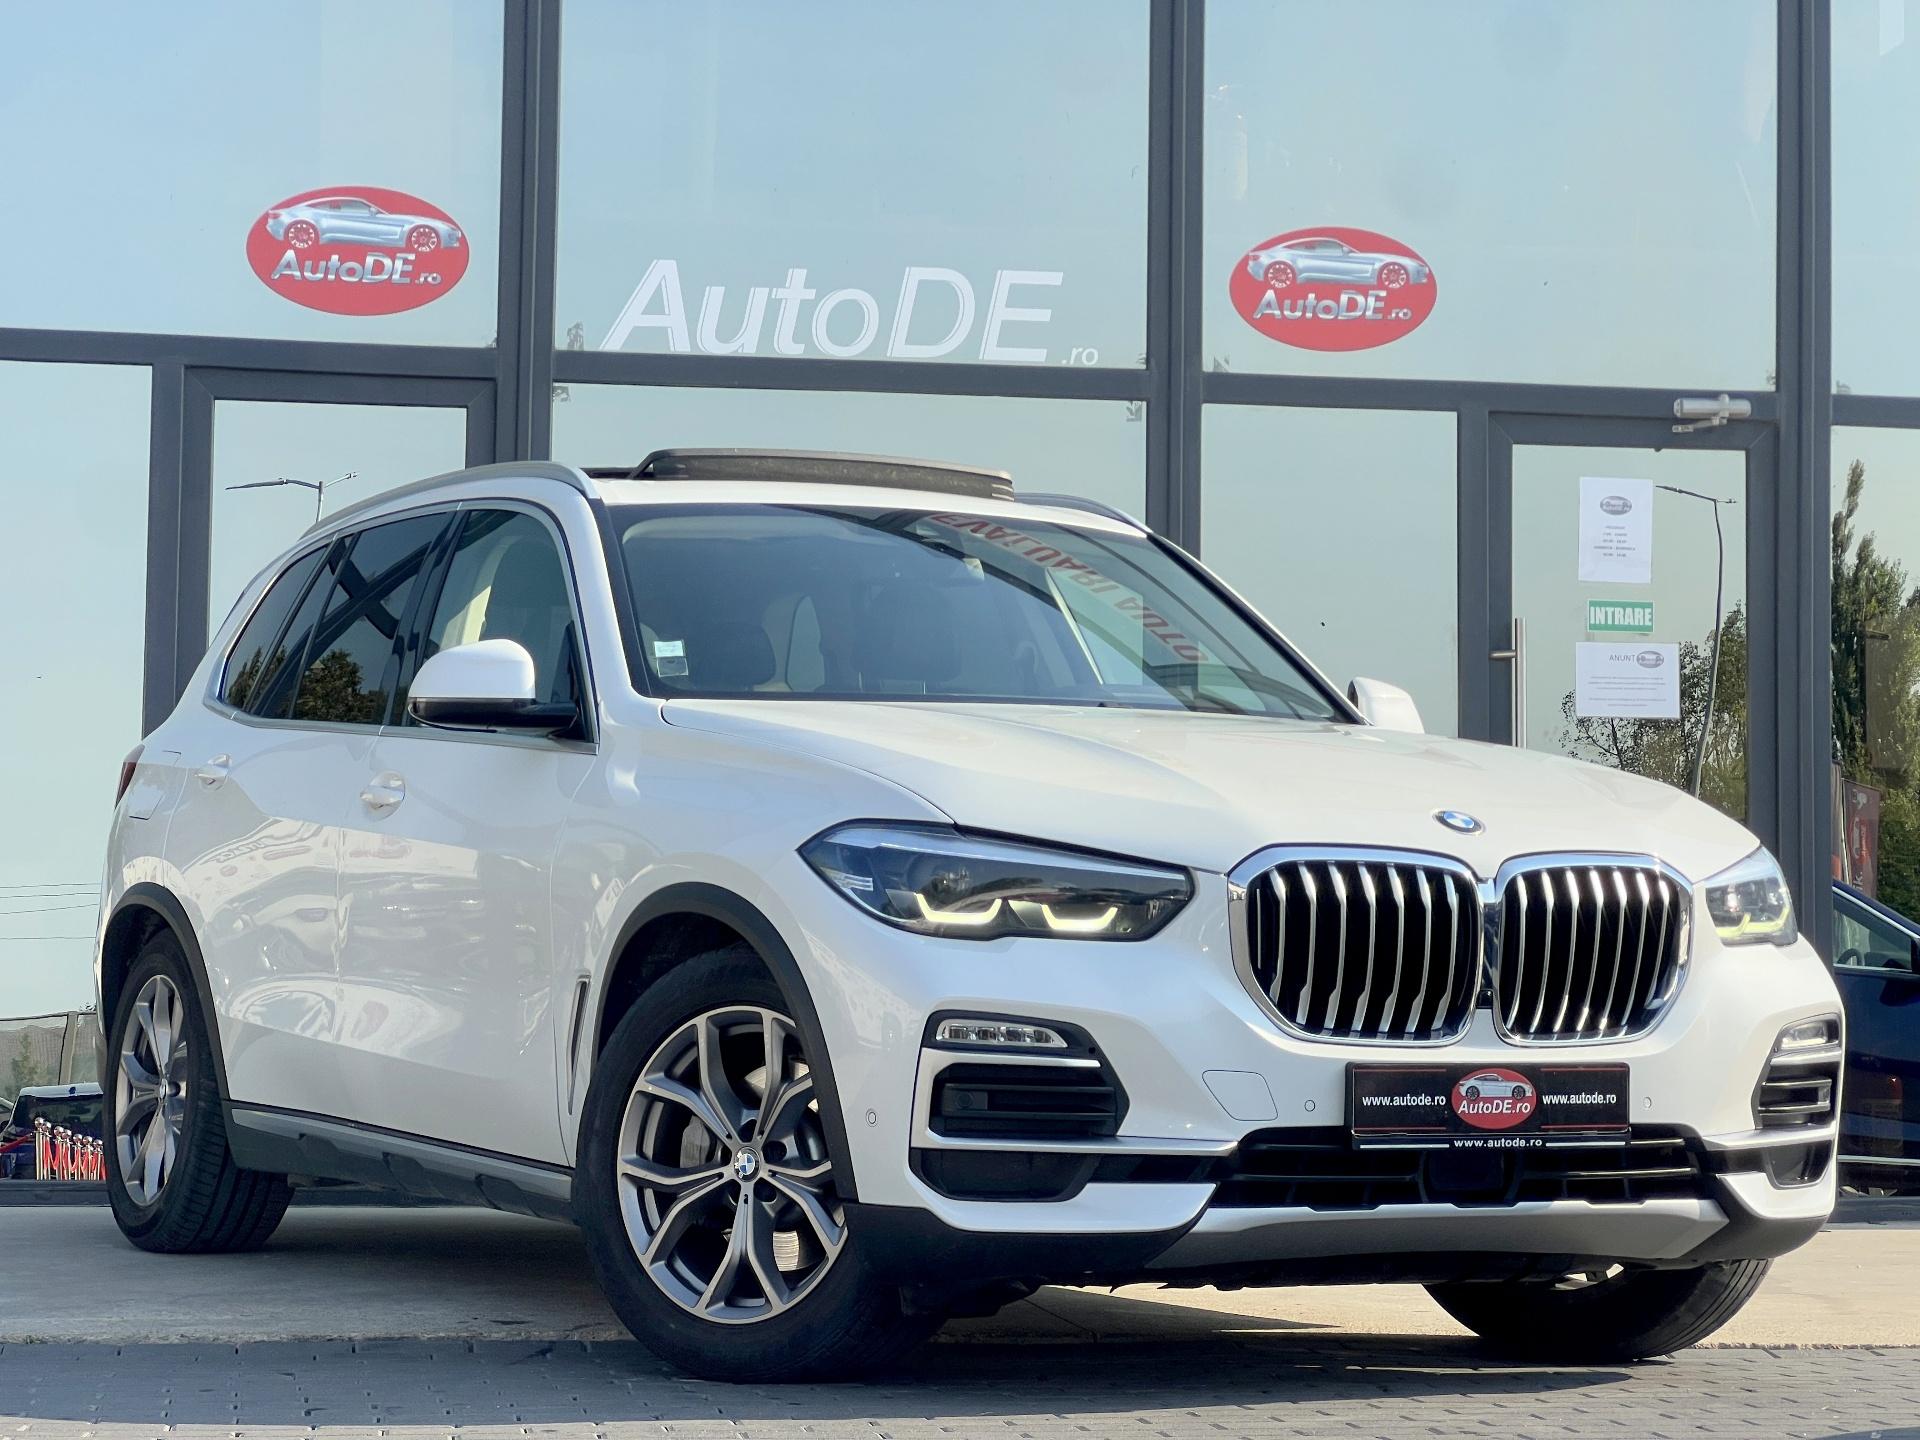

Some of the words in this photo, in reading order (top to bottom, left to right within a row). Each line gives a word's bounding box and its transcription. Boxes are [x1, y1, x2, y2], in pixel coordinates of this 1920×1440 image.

[1589, 606, 1653, 626] INTRARE
[1362, 1094, 1447, 1106] www.autode.ro
[1542, 1091, 1617, 1105] www.autode.ro
[1457, 1099, 1531, 1114] AutoDE.ro
[1453, 1137, 1543, 1148] www.autode.ro
